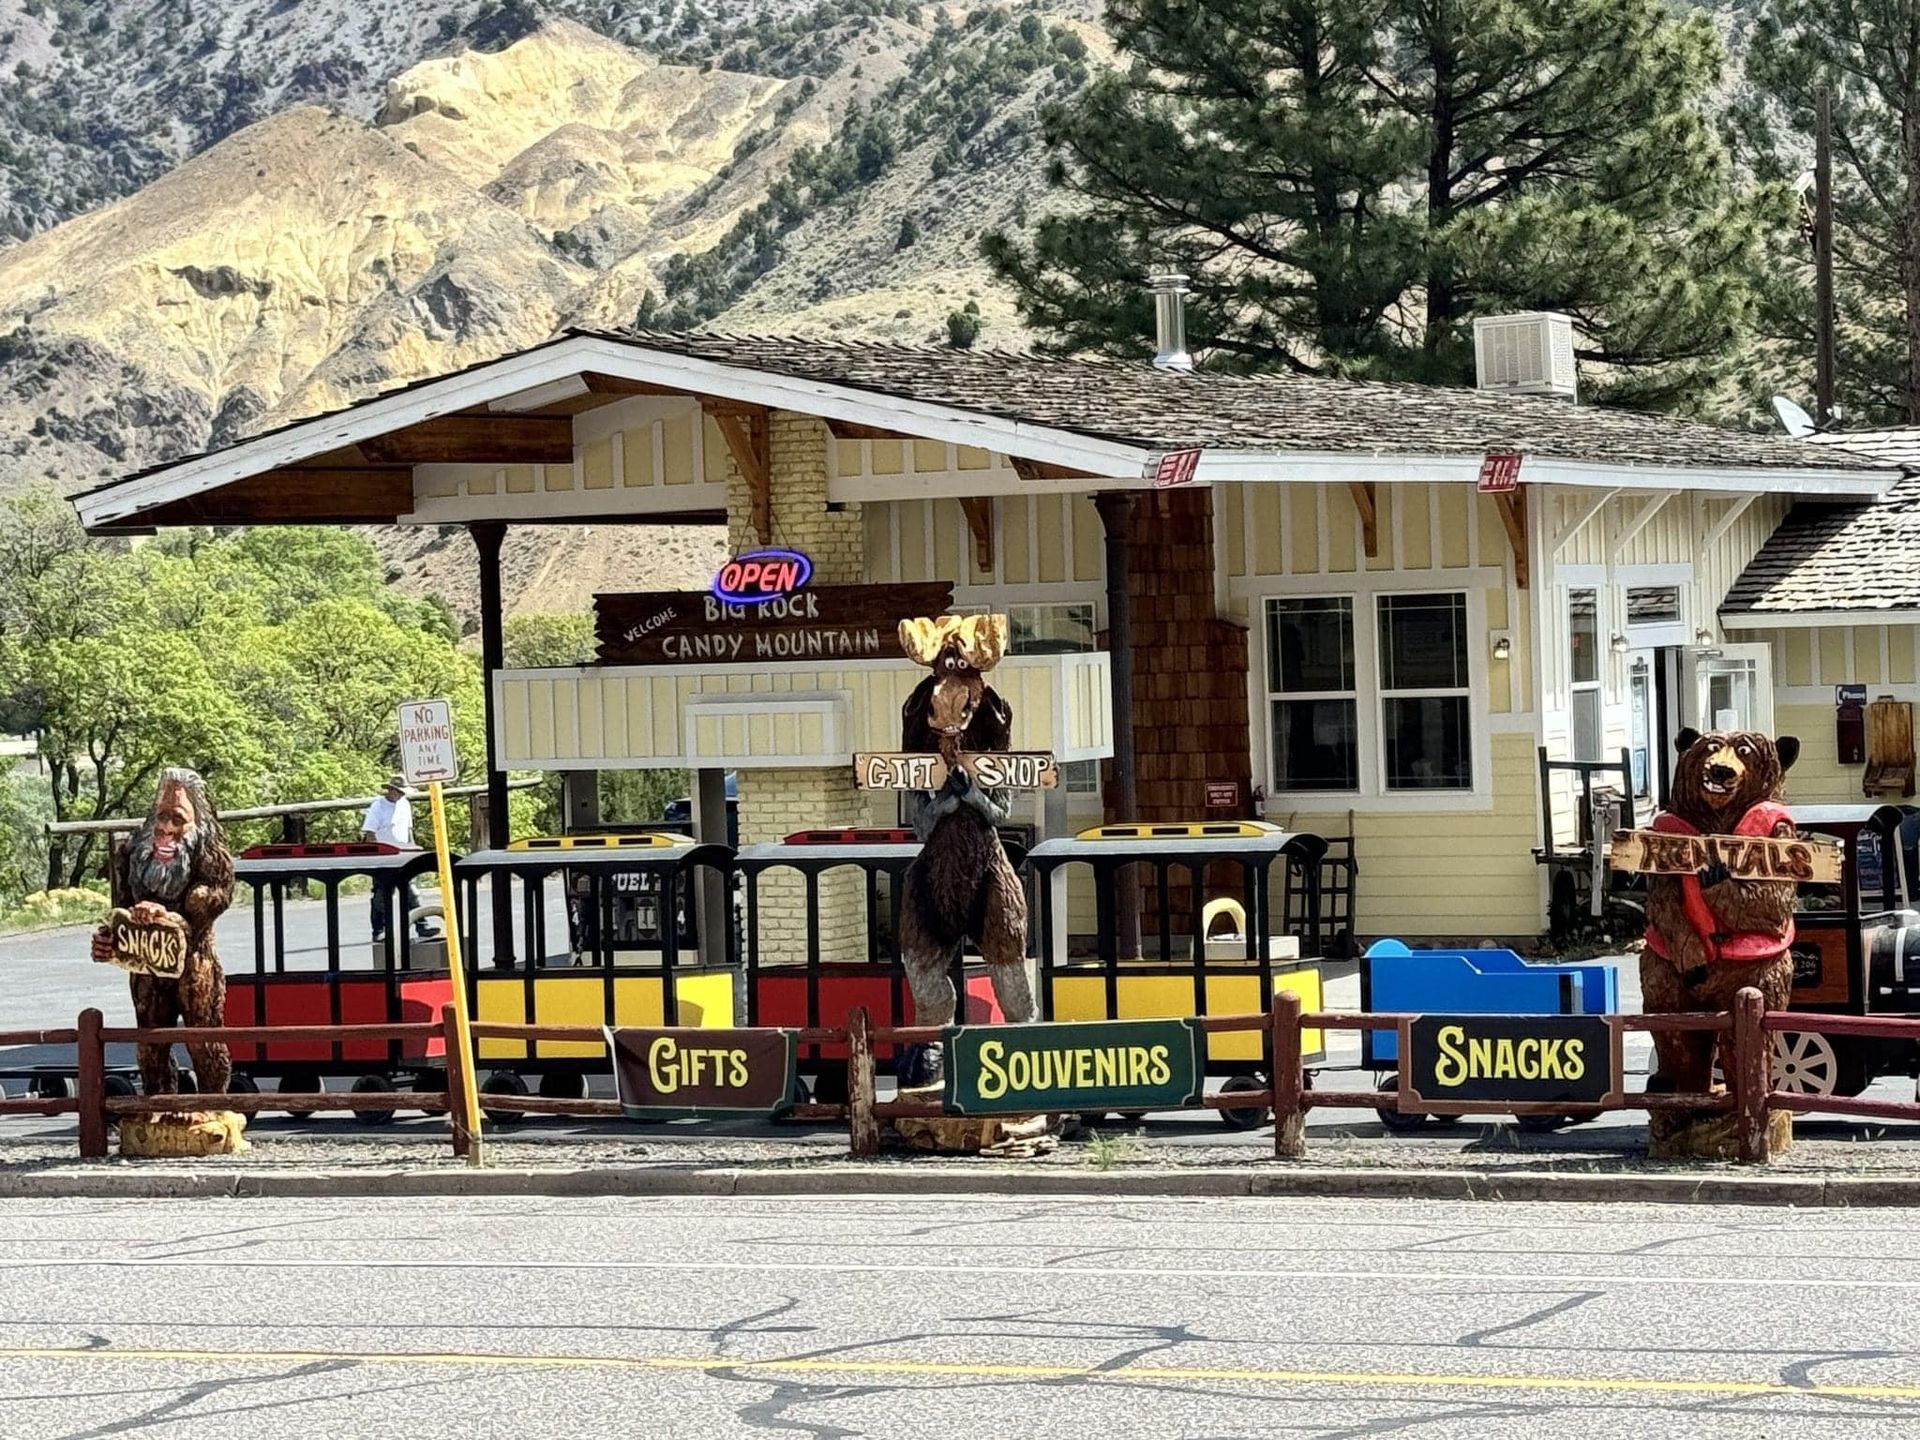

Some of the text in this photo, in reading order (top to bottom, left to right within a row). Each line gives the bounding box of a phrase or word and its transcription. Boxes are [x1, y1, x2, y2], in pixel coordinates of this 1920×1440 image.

[719, 562, 799, 592] OPEN
[623, 606, 677, 643] WELCOME
[662, 629, 880, 660] CANDY MOUNTAIN
[414, 707, 433, 723] NO
[404, 724, 449, 743] PARKING
[418, 742, 438, 754] ANY
[418, 754, 441, 766] TIME
[612, 873, 651, 891] UEL
[117, 923, 179, 969] SNACKS
[648, 1037, 749, 1094] GIFTS
[977, 1040, 1171, 1099] SOUVENIRS
[1434, 1025, 1585, 1087] SNACKS
